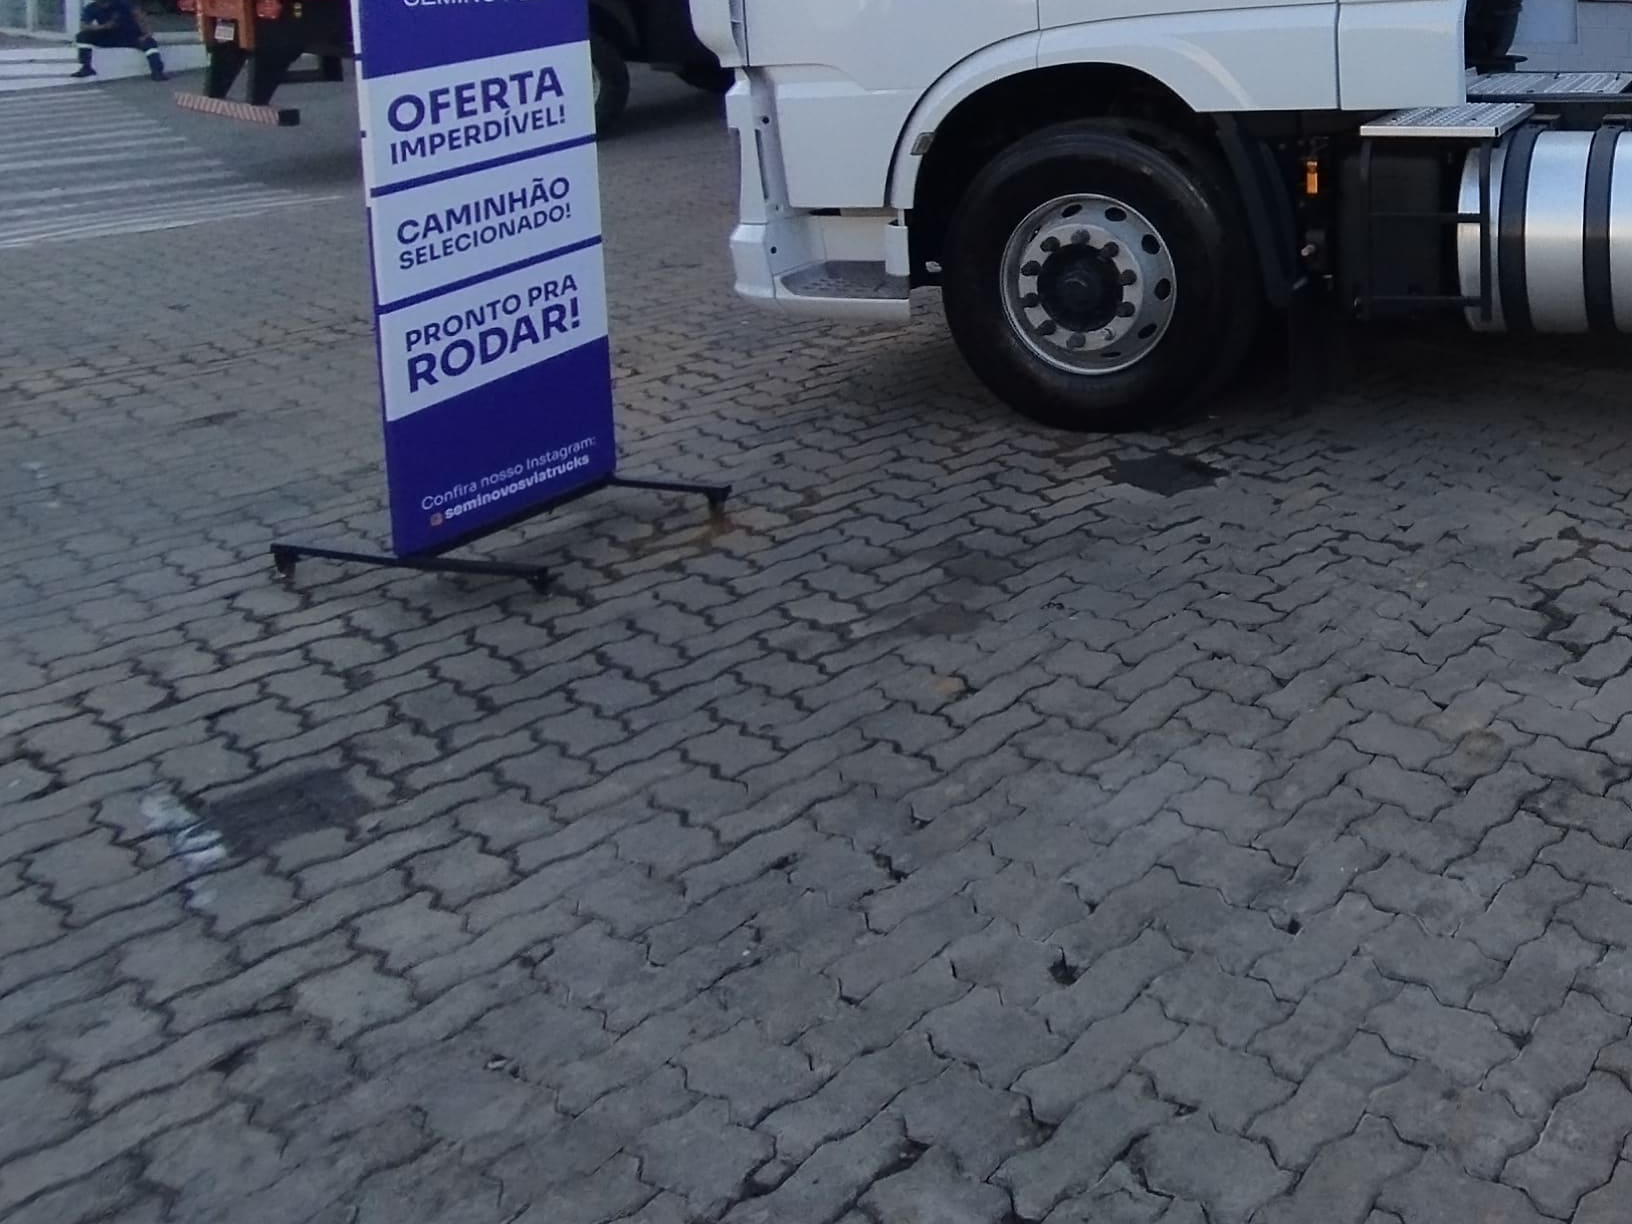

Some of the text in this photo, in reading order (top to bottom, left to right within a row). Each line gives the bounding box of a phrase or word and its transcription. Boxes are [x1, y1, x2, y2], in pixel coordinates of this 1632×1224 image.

[387, 66, 565, 134] OFERTA
[390, 104, 567, 165] IMPERDÍVEL!
[397, 177, 570, 245] CAMINHÃO
[399, 202, 572, 270] SELECIONADO!
[405, 274, 578, 353] PRONTO PRA
[407, 297, 580, 394] RODAR!
[421, 435, 597, 511] Confira nosso Instagram:
[444, 453, 590, 520] seminovosviatrucks
